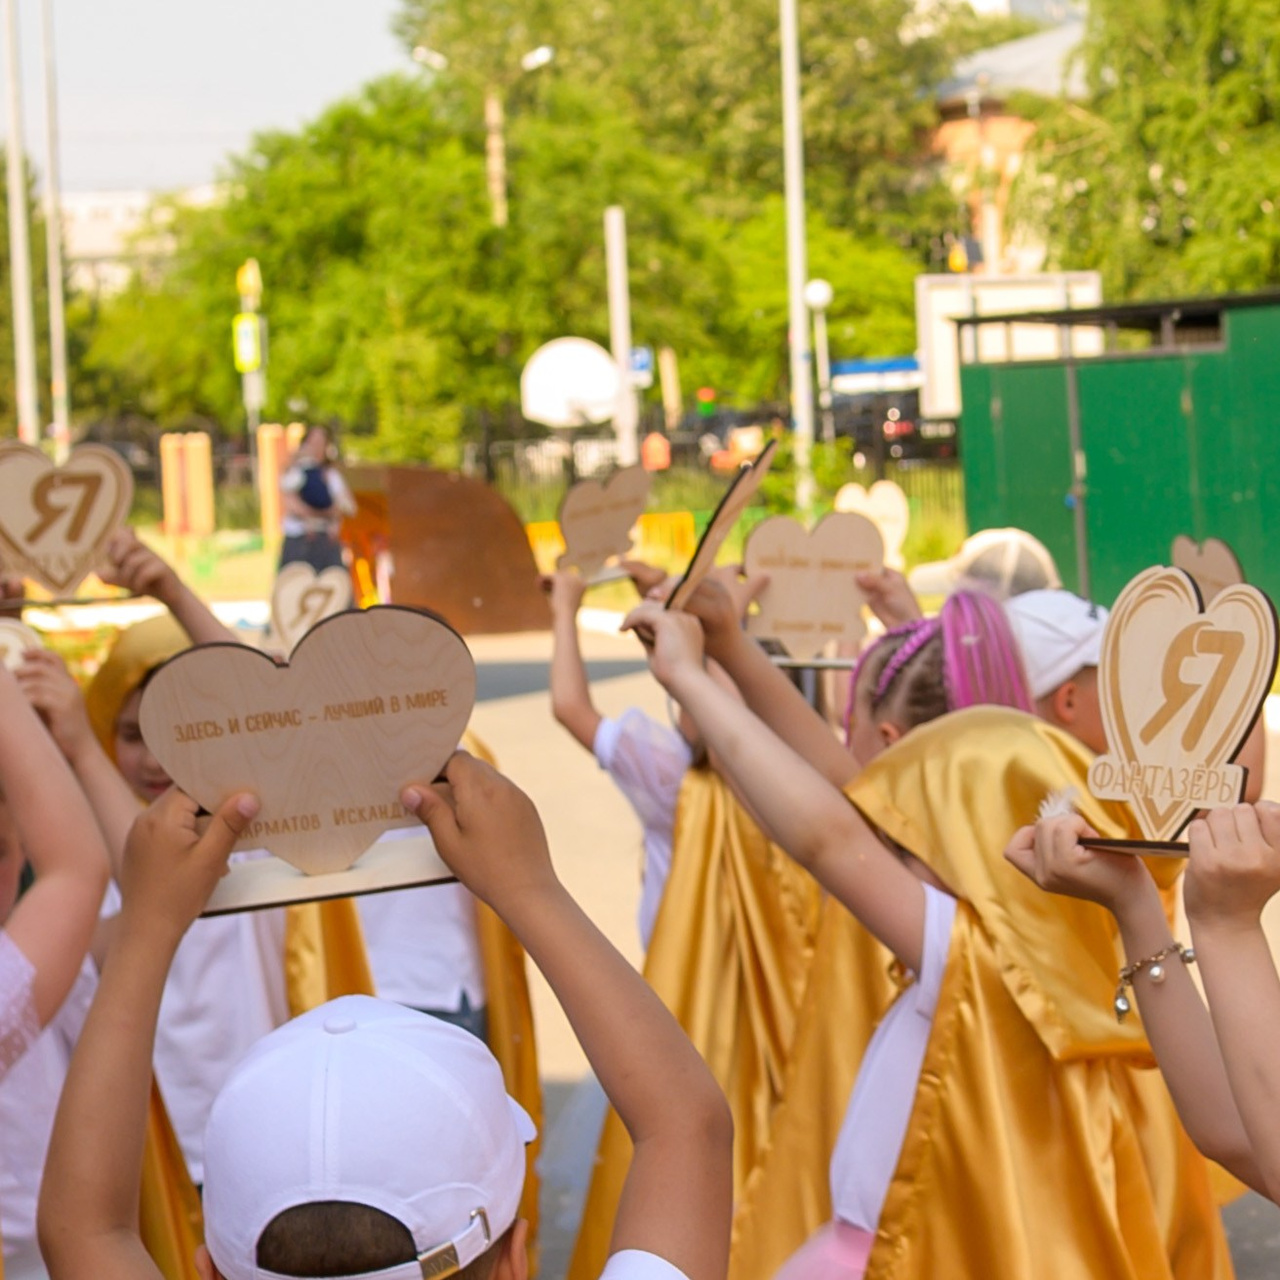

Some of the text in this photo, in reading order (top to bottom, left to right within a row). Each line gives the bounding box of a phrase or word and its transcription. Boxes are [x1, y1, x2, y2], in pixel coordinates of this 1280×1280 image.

[25, 473, 103, 546] Я
[1139, 620, 1245, 753] Я
[174, 720, 224, 743] ЗДЕСЬ
[229, 717, 241, 734] И
[245, 709, 302, 733] СЕЙЧАС
[324, 696, 385, 721] ЛУЧШИЙ
[391, 695, 401, 713] В
[406, 689, 449, 710] МИРЕ
[1092, 761, 1239, 803] ФАНТАЗЁРЫ
[239, 813, 321, 839] АРМАТОВ
